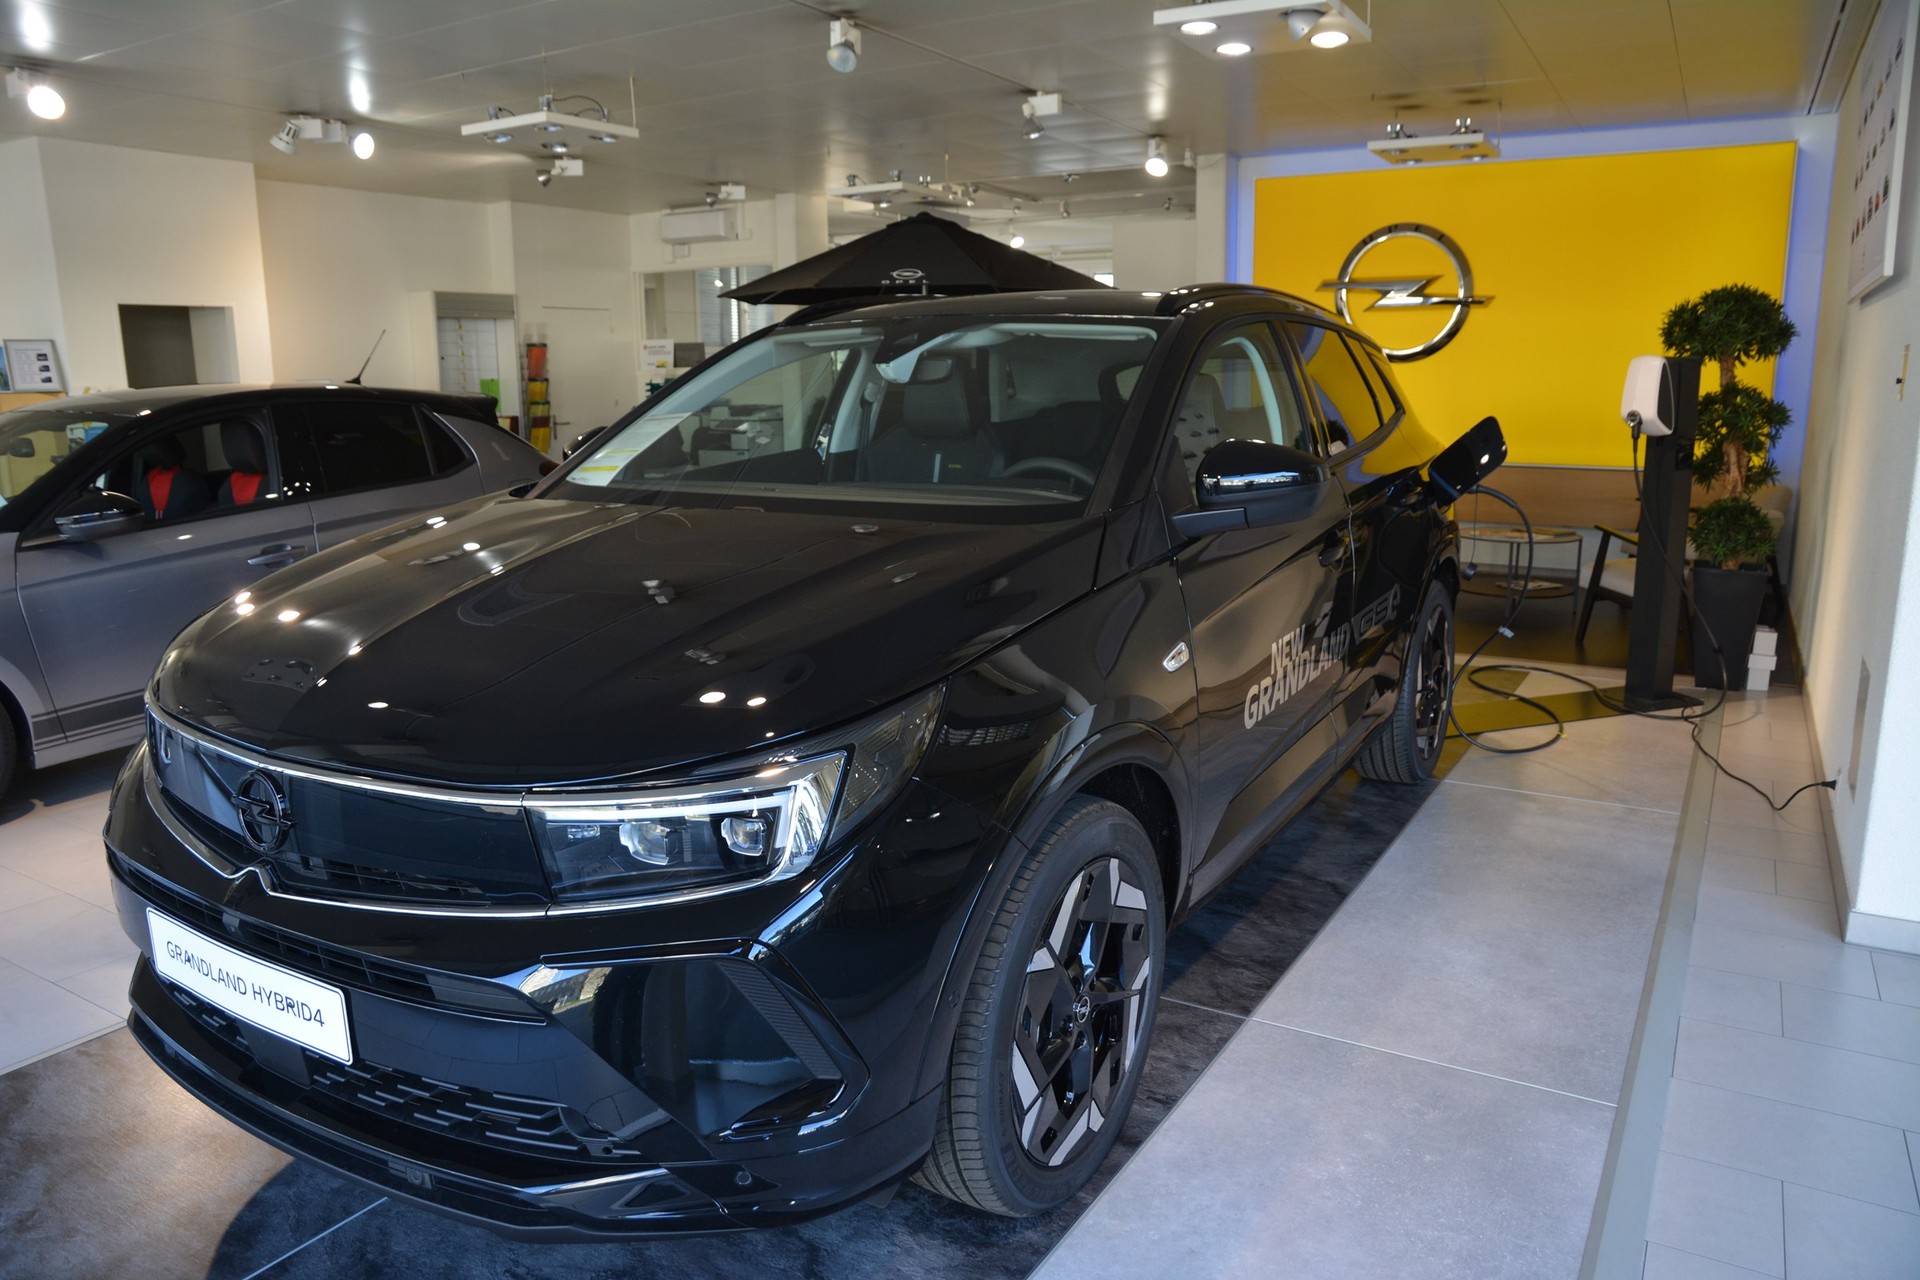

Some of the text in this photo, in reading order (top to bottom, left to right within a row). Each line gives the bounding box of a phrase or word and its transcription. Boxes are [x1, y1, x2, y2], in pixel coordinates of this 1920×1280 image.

[1244, 622, 1350, 729] GRANDLAND
[1271, 624, 1306, 675] NEW
[166, 940, 325, 1027] GRANDLAND HYBRID4
